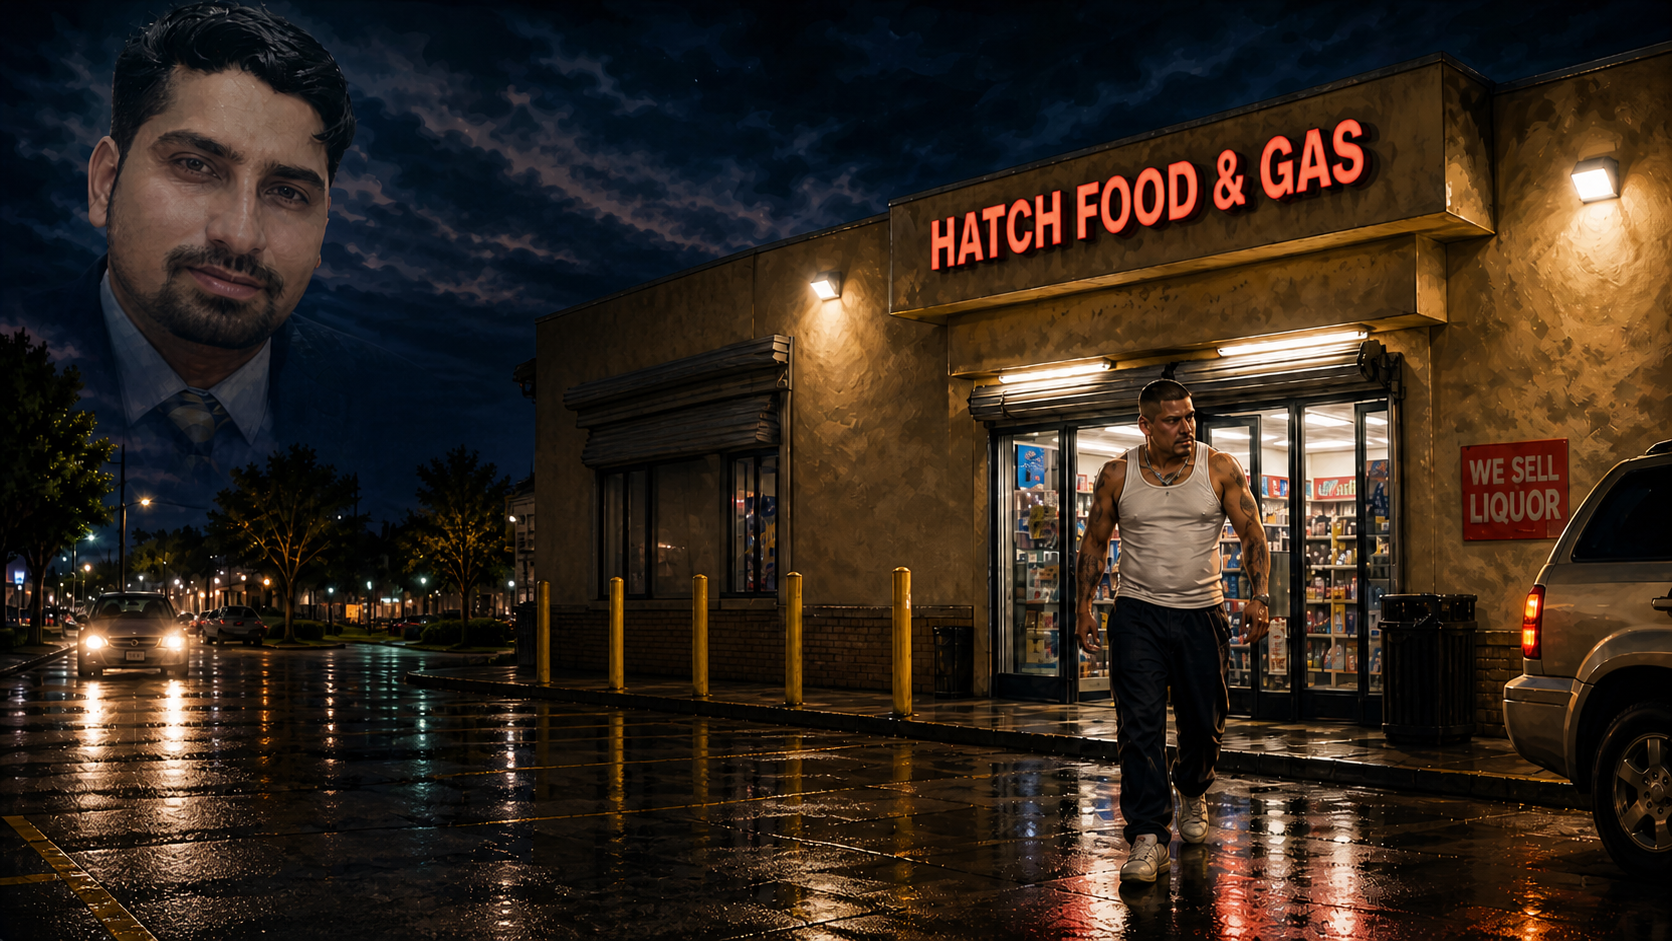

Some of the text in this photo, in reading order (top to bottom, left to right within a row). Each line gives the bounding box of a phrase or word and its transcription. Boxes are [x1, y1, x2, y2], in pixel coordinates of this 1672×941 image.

[931, 118, 1365, 270] HATCH FOOD & GAS
[1469, 454, 1560, 486] WE SELL
[1469, 488, 1562, 525] LIQUOR
